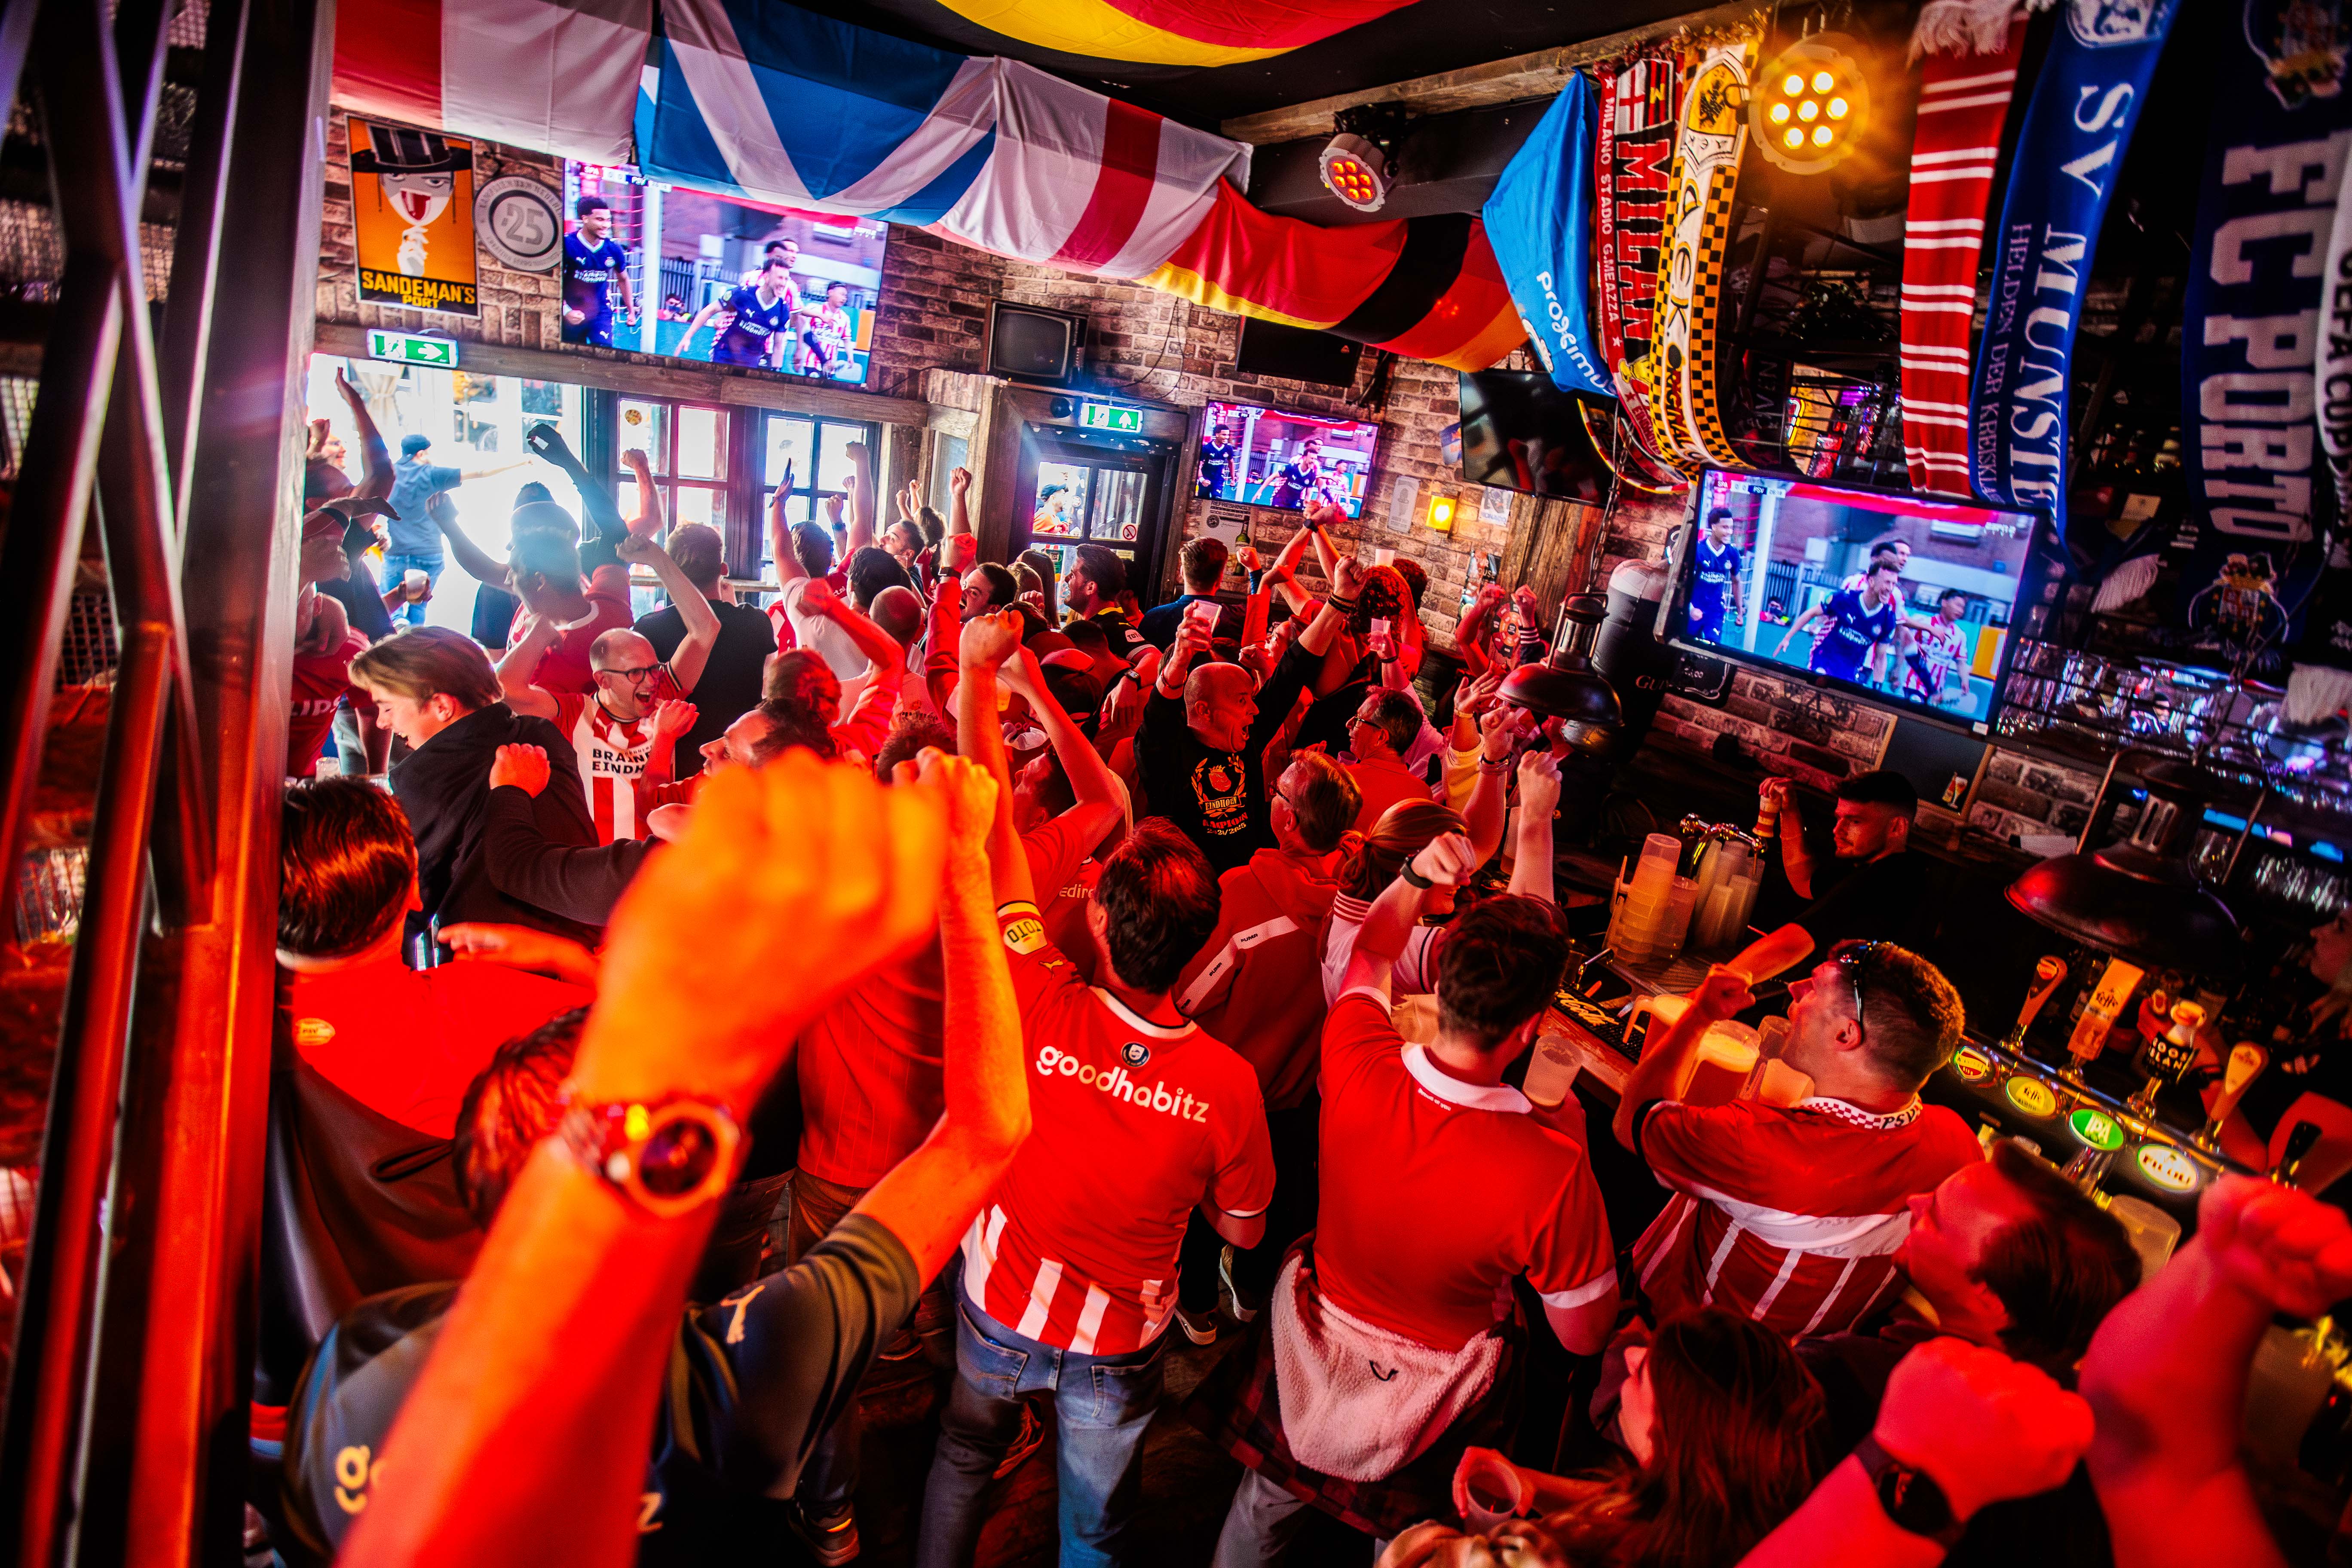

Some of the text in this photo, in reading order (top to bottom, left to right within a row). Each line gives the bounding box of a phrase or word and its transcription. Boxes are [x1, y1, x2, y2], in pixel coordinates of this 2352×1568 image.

[2060, 83, 2135, 200] SV
[1600, 98, 1619, 322] MILANO STADIO G.MEAZZA
[1616, 140, 1670, 340] MILAN
[362, 271, 476, 304] SANDEMAN'S
[402, 295, 441, 309] PORT
[1994, 223, 2032, 334] HELDEN
[1984, 343, 2009, 395] DER
[2010, 223, 2088, 512] MUNSTE
[2200, 309, 2318, 542] PORTO
[1209, 962, 1222, 977] PUMA
[1240, 933, 1258, 943] PUMA
[1036, 1044, 1210, 1124] goodhabitz
[1882, 1109, 1915, 1129] PSV
